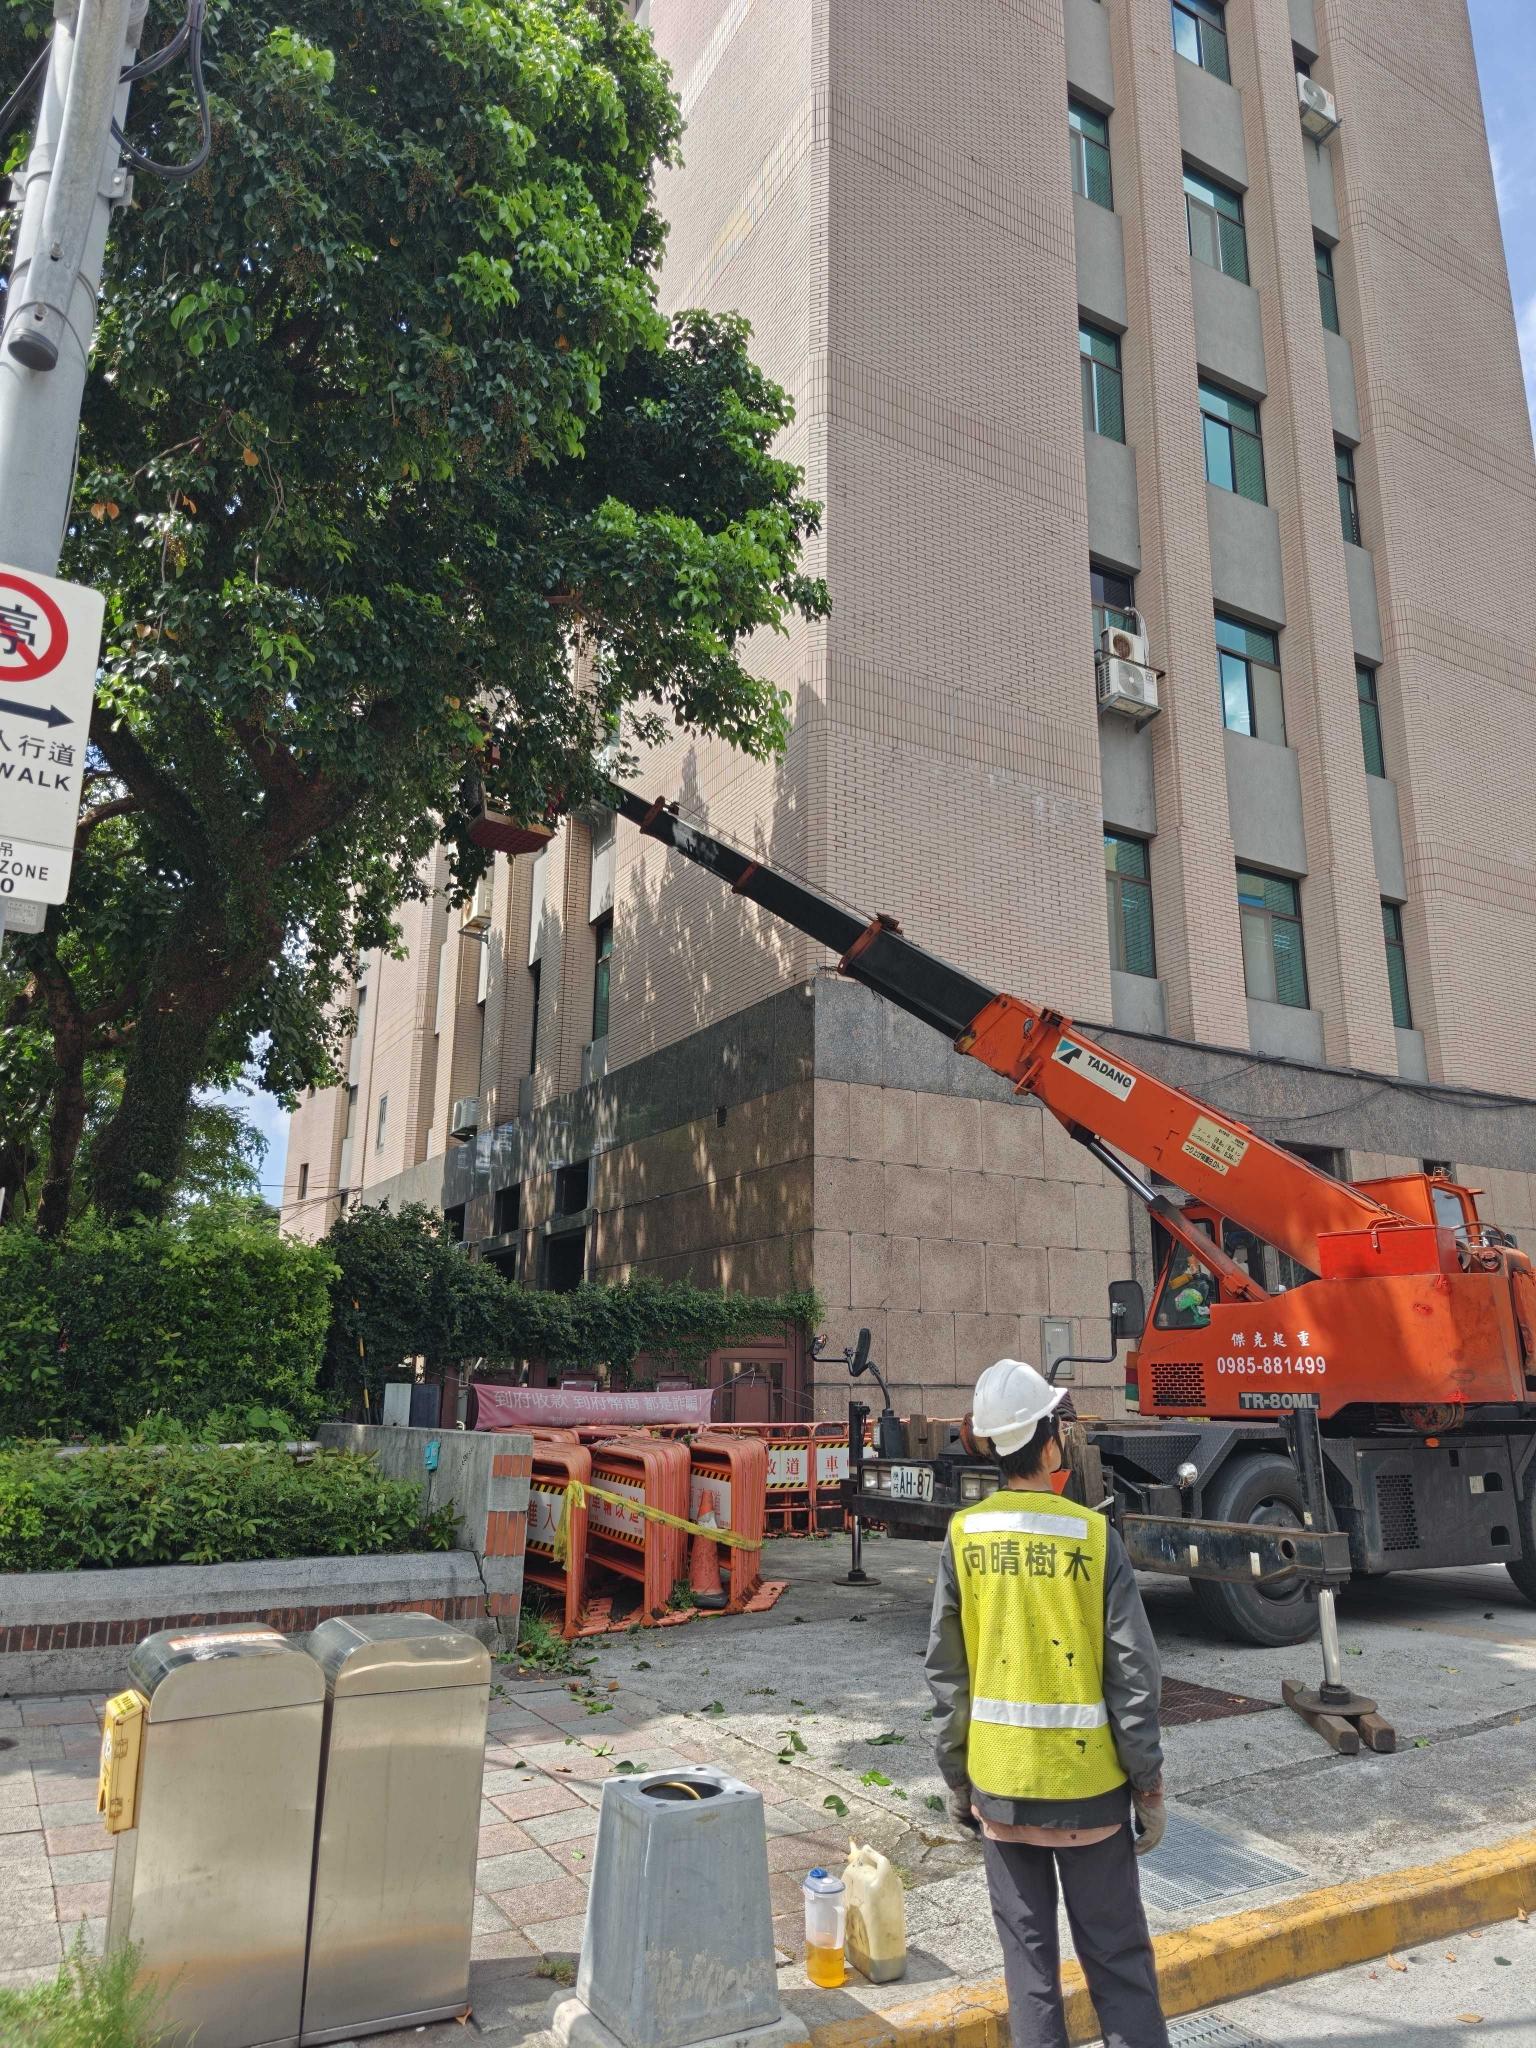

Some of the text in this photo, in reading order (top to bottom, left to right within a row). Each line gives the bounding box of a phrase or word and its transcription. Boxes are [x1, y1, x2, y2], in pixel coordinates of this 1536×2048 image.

[0, 860, 49, 881] ZONE
[1087, 1055, 1132, 1088] TADANO
[1216, 1355, 1326, 1375] 0985-881499
[1240, 1392, 1319, 1409] TR-80ML
[962, 1539, 1093, 1582] 向晴樹木
